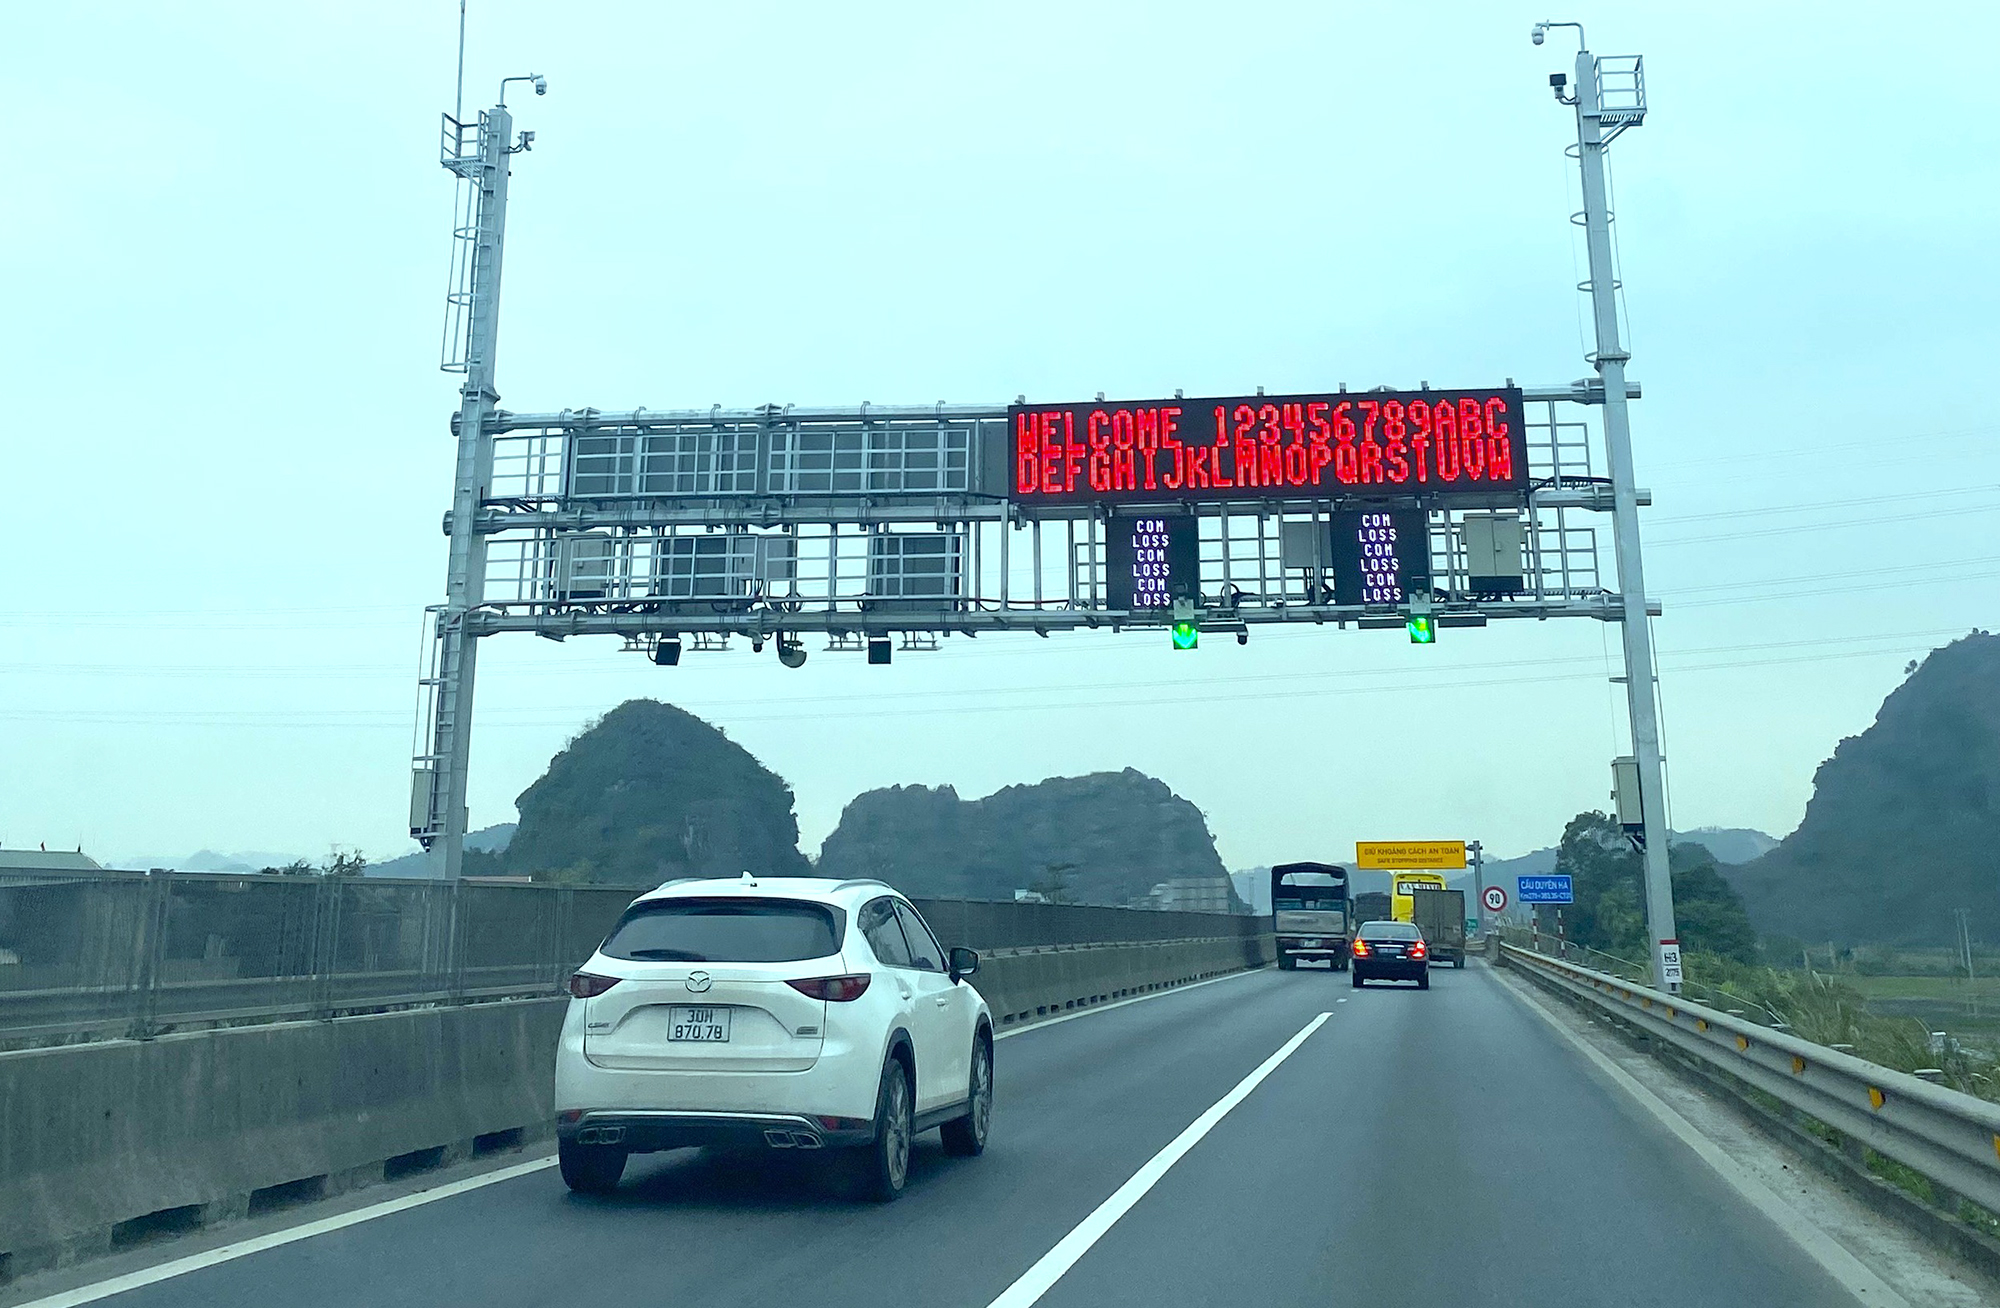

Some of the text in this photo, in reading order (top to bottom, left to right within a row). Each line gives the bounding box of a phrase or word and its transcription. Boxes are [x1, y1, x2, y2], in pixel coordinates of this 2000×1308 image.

[1017, 397, 1510, 454] WELCOME 123456789ABC
[1017, 438, 1513, 494] DEFGHIJKLMNOPQRSTUVW
[1136, 520, 1164, 533] COM
[1362, 513, 1391, 527] COM
[1132, 534, 1169, 548] LOSS
[1358, 528, 1397, 542] LOSS
[1137, 549, 1165, 562] COM
[1364, 543, 1393, 557] COM
[1132, 563, 1170, 577] LOSS
[1360, 558, 1399, 572] LOSS
[1137, 578, 1166, 592] COM
[1366, 573, 1395, 587] COM
[1133, 593, 1171, 606] LOSS
[1362, 587, 1402, 602] LOSS
[1429, 847, 1439, 855] AN
[1489, 893, 1501, 904] 90
[1663, 952, 1678, 963] H3
[687, 1009, 713, 1023] 30H
[675, 1025, 723, 1039] 870.78
